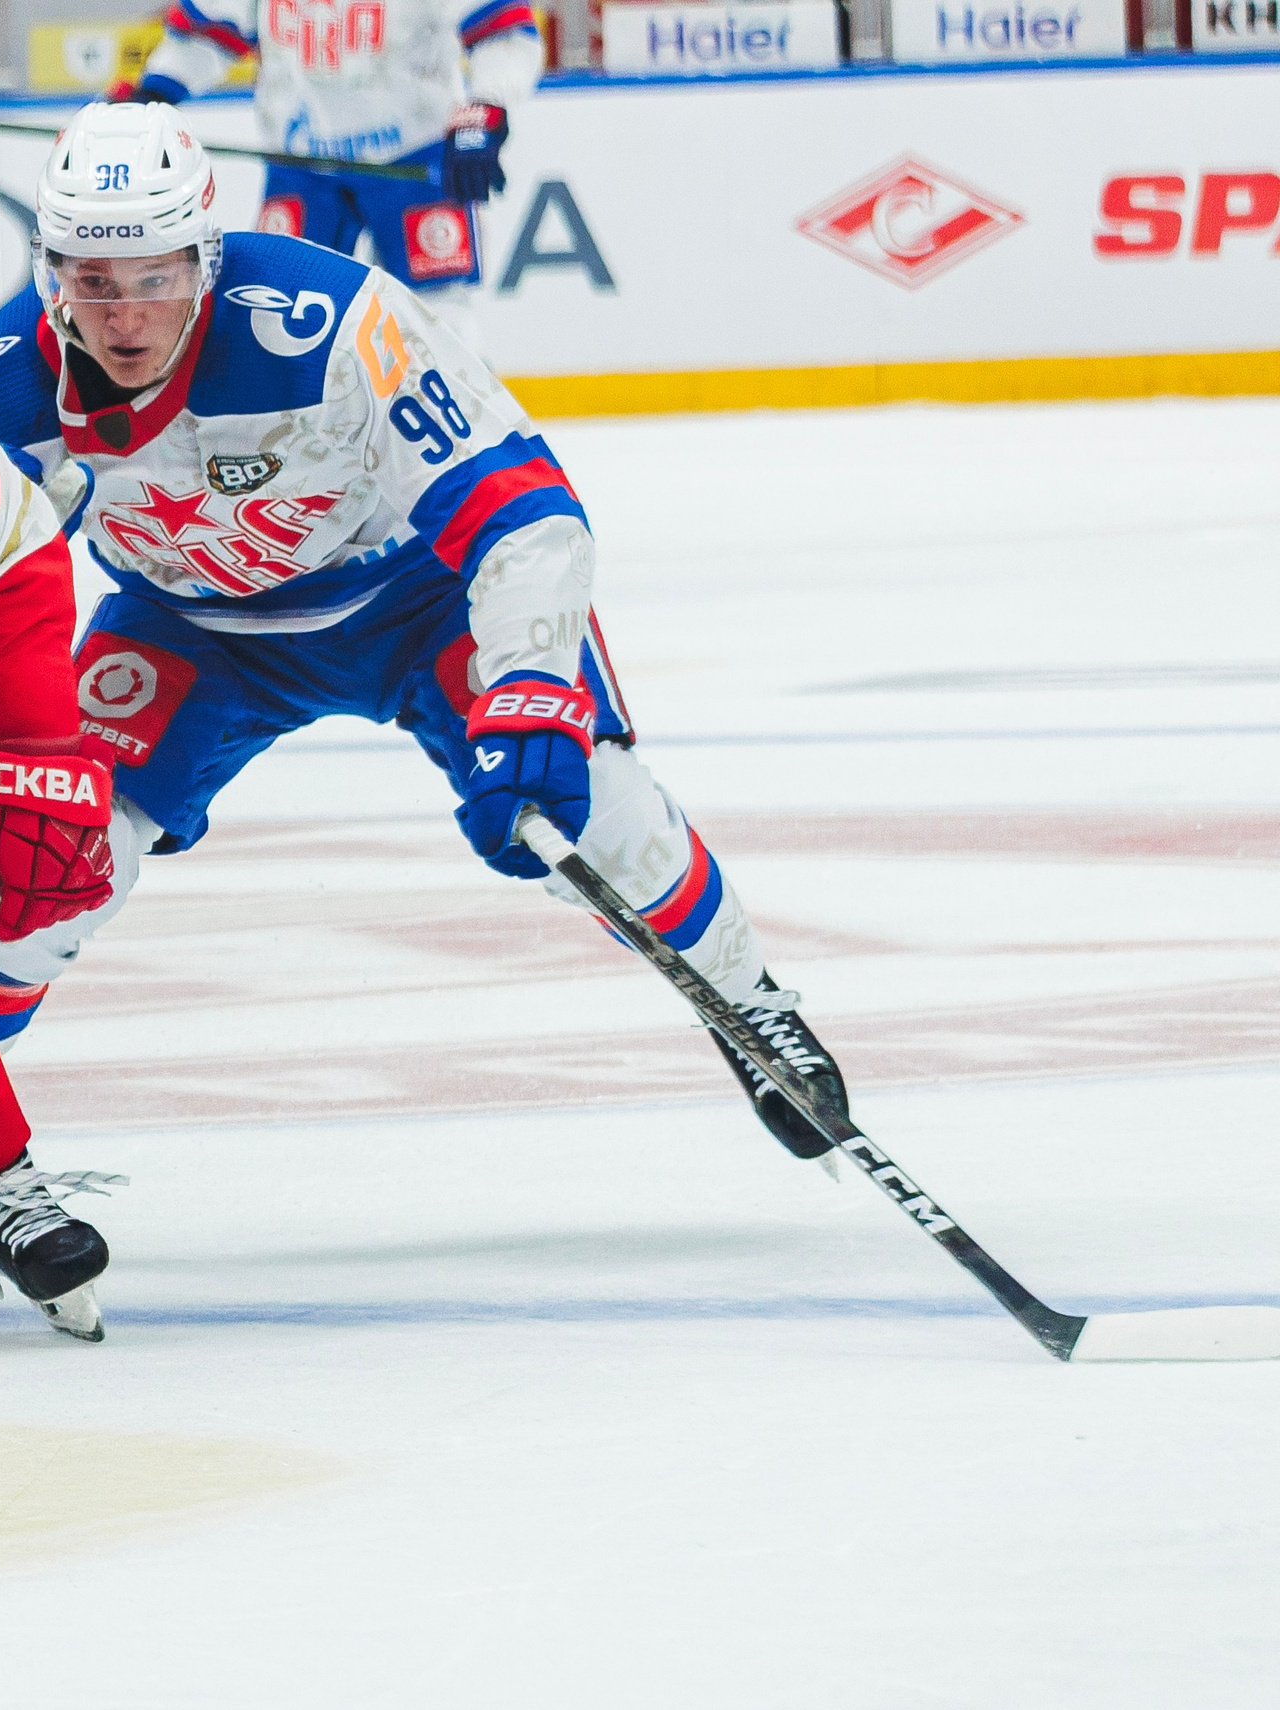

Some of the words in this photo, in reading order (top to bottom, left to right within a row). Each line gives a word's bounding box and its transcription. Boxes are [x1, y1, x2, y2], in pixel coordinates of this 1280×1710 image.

[646, 16, 790, 64] Haier
[936, 5, 1081, 50] Haier
[96, 163, 130, 191] 98
[76, 224, 145, 239] согаз
[1094, 172, 1280, 255] SP
[389, 369, 471, 465] 98
[220, 460, 270, 487] 80
[840, 1135, 957, 1234] CCM
